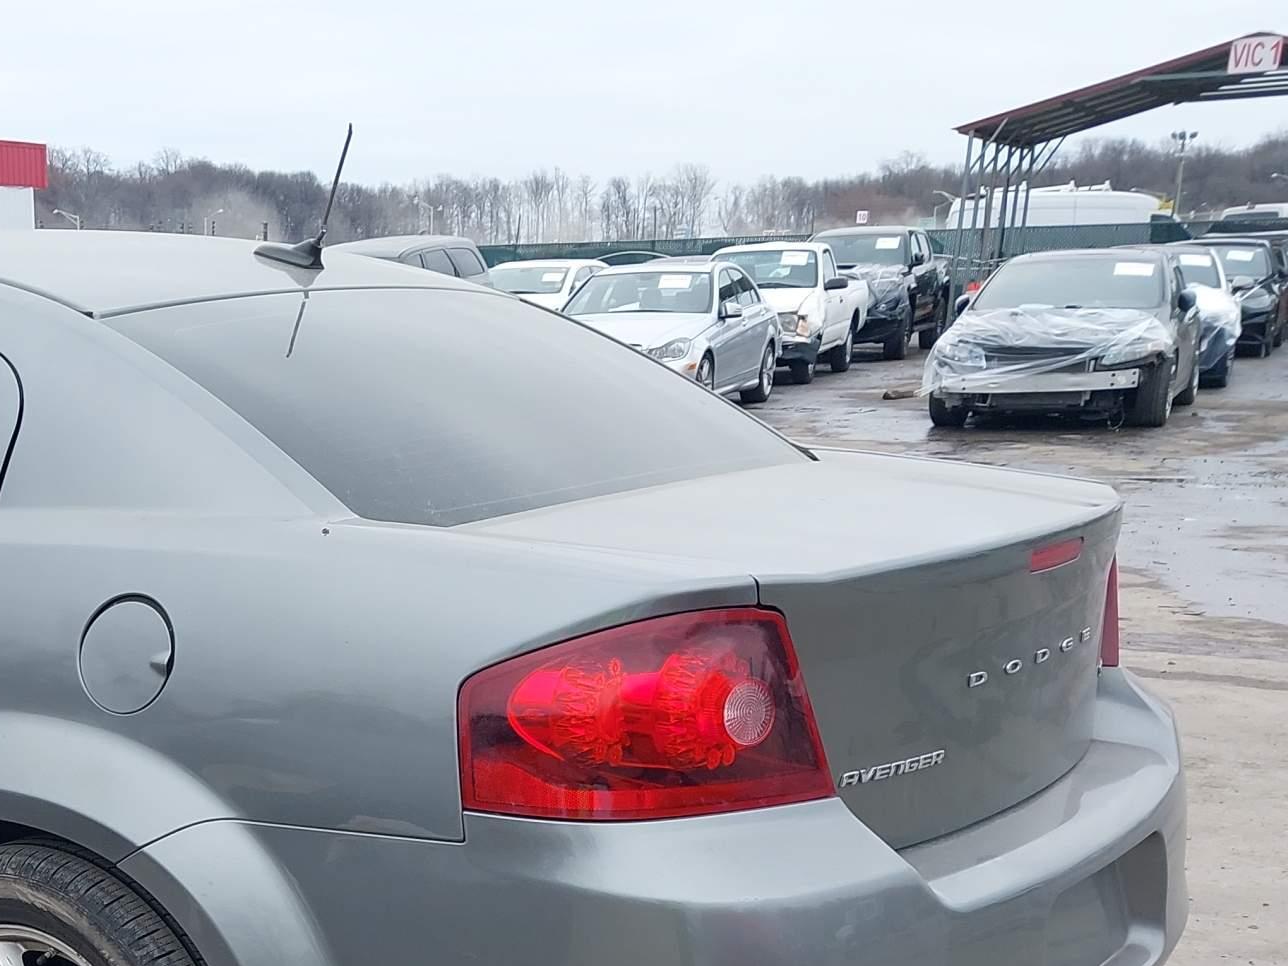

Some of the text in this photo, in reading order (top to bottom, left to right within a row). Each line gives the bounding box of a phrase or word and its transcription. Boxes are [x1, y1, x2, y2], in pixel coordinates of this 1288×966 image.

[1234, 41, 1281, 69] VIC 1
[968, 627, 1091, 688] DODGE
[839, 749, 945, 788] AVENGER
